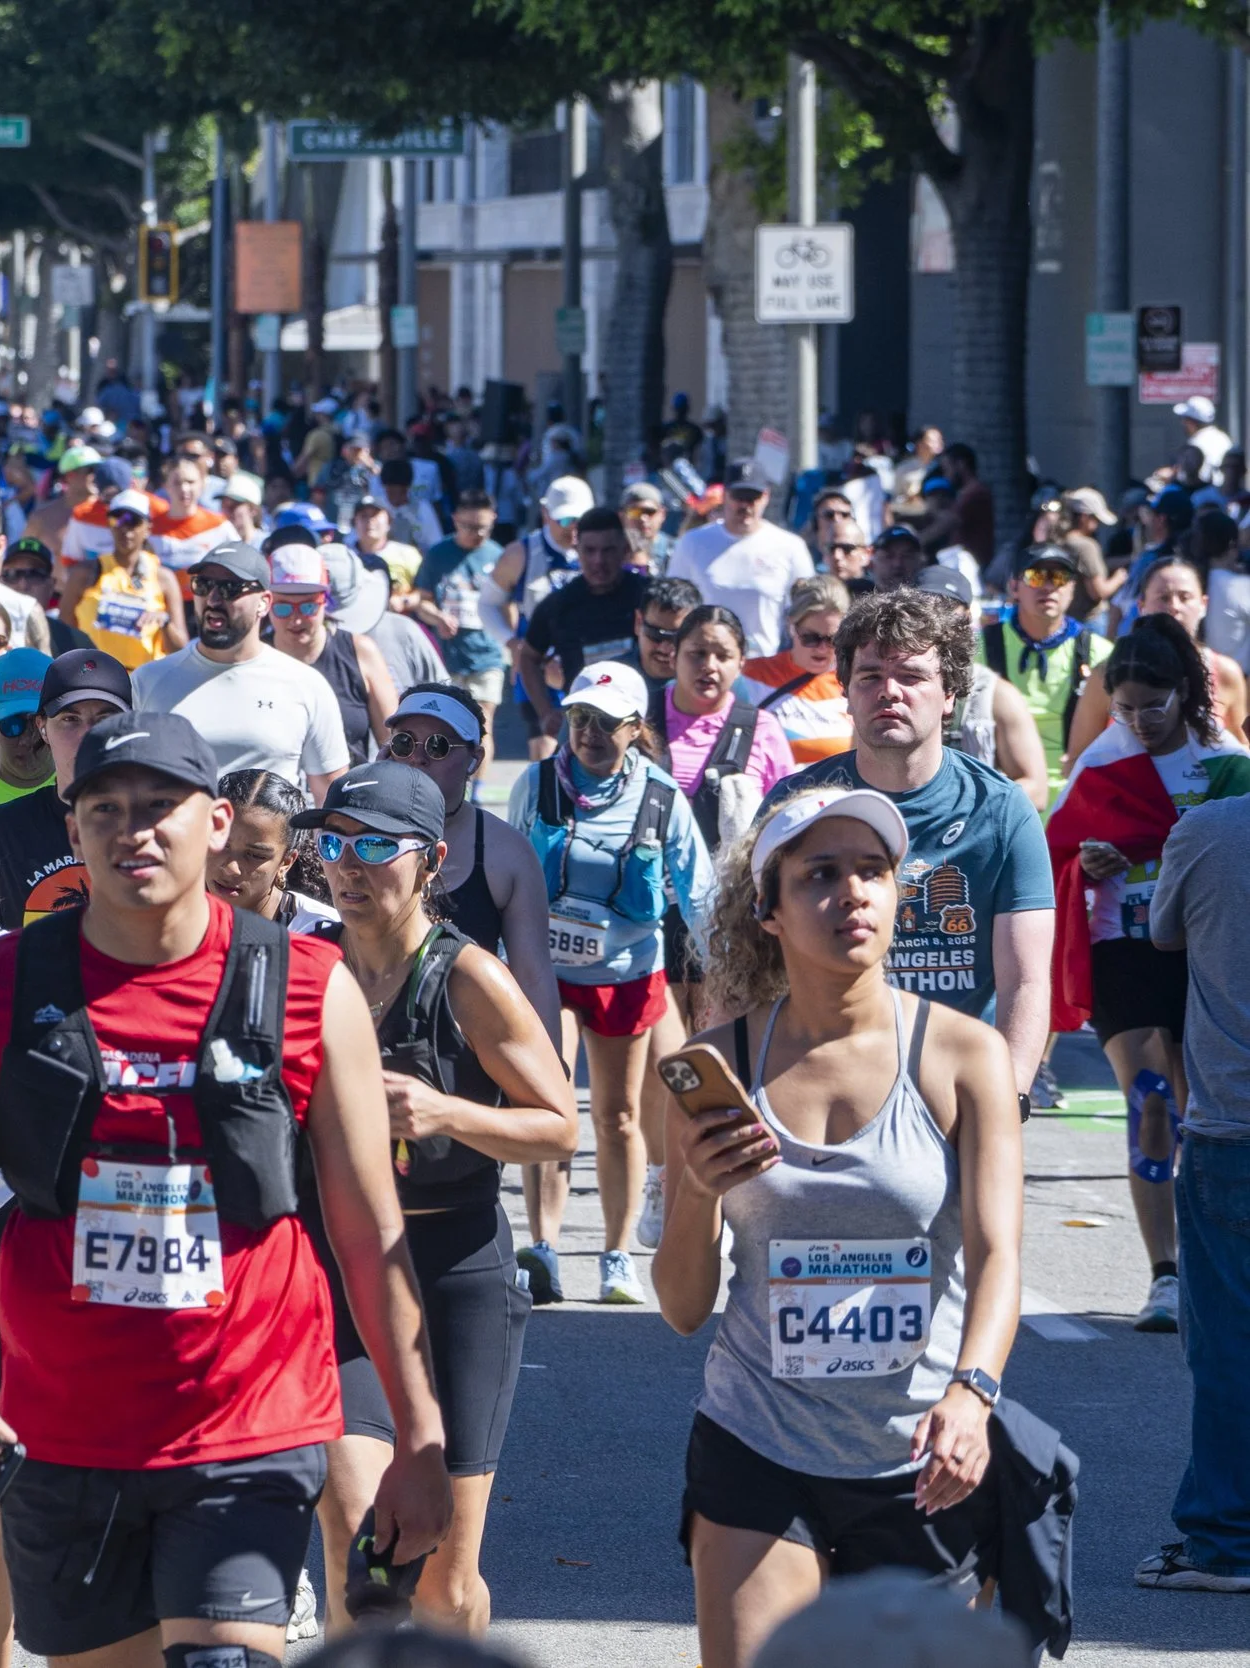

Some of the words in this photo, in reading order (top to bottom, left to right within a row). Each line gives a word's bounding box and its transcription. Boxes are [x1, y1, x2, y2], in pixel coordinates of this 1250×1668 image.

[26, 870, 45, 887] LA
[947, 918, 968, 932] 66
[949, 935, 976, 945] 2026
[116, 1179, 134, 1189] LOS
[142, 1182, 188, 1194] ANGELES
[116, 1190, 188, 1204] MARATHON
[85, 1231, 210, 1274] E7984
[808, 1253, 830, 1262] LOS
[840, 1252, 892, 1262] ANGELES
[808, 1263, 892, 1275] MARATHON
[138, 1291, 169, 1304] asics
[778, 1305, 923, 1344] C4403
[843, 1359, 875, 1372] asics
